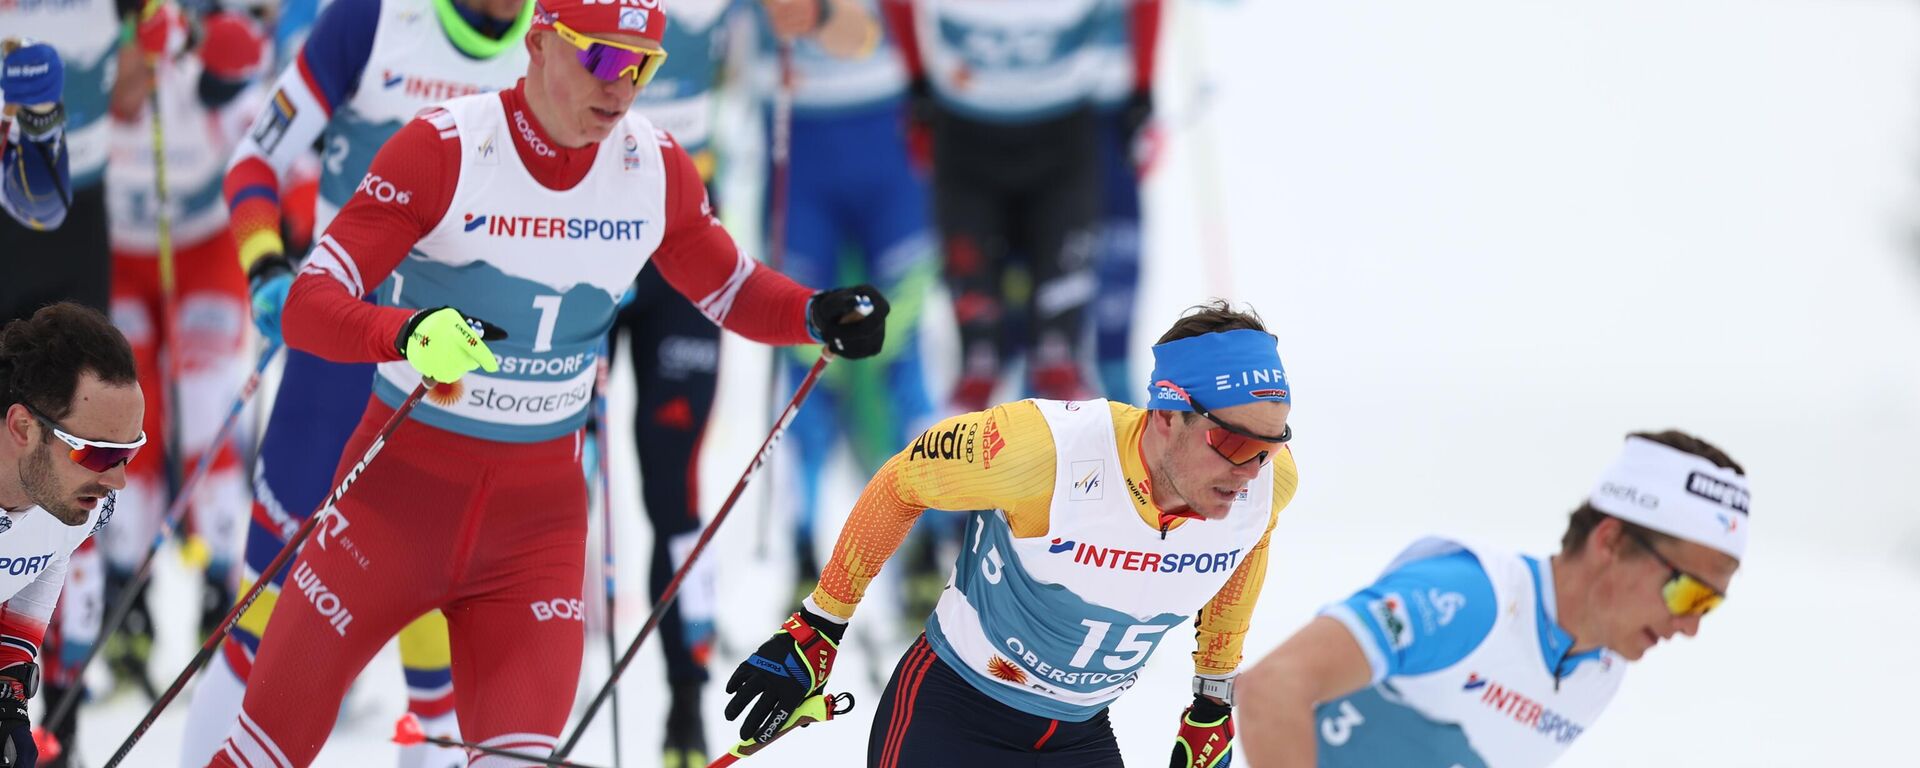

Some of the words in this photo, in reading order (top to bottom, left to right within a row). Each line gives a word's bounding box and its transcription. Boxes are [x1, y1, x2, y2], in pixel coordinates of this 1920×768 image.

[489, 215, 646, 241] INTERSPORT
[532, 294, 563, 353] 1
[910, 424, 967, 461] Audi
[1073, 542, 1241, 574] INTERSPORT
[293, 561, 357, 637] LUKOIL
[1005, 637, 1127, 685] OBERSTDO
[1068, 618, 1170, 671] 15
[759, 709, 788, 743] Roeckl
[1482, 683, 1584, 744] INTERSPORT
[1192, 733, 1219, 768] LEK
